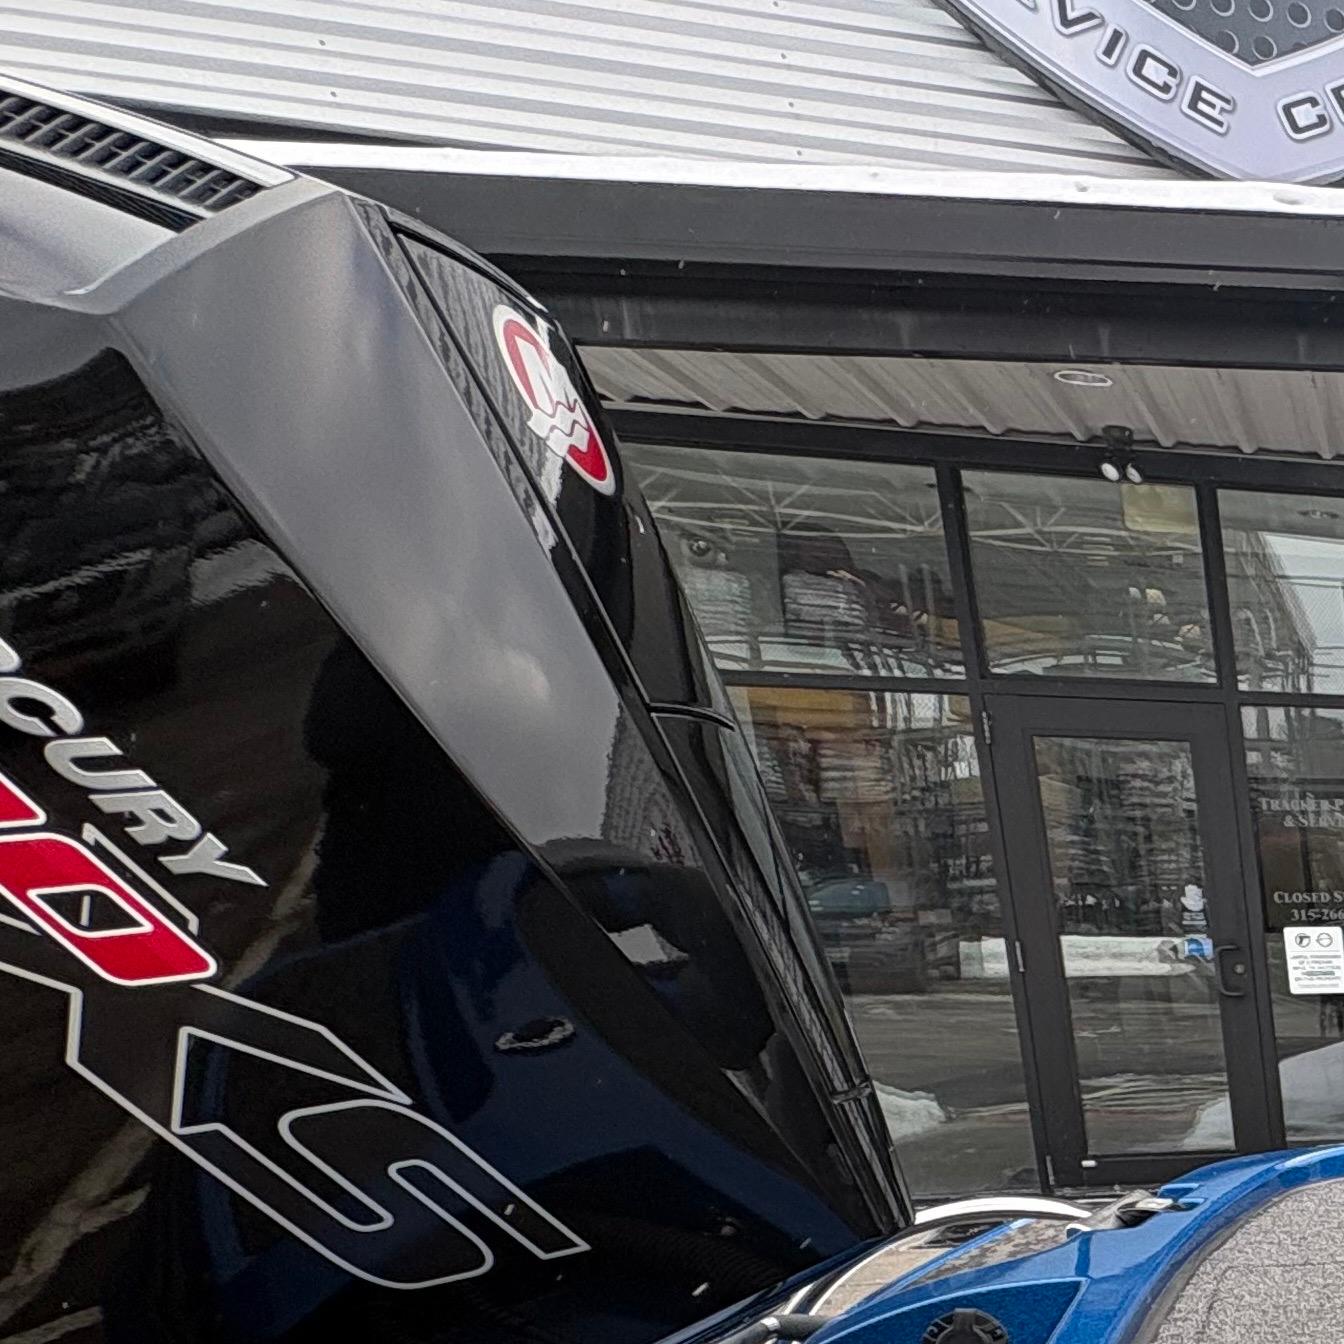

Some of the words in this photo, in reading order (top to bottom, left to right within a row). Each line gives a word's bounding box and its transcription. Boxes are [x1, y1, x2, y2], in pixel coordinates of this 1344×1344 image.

[1016, 0, 1236, 133] VICE
[0, 637, 269, 887] CURY
[1273, 890, 1332, 904] CLOSED
